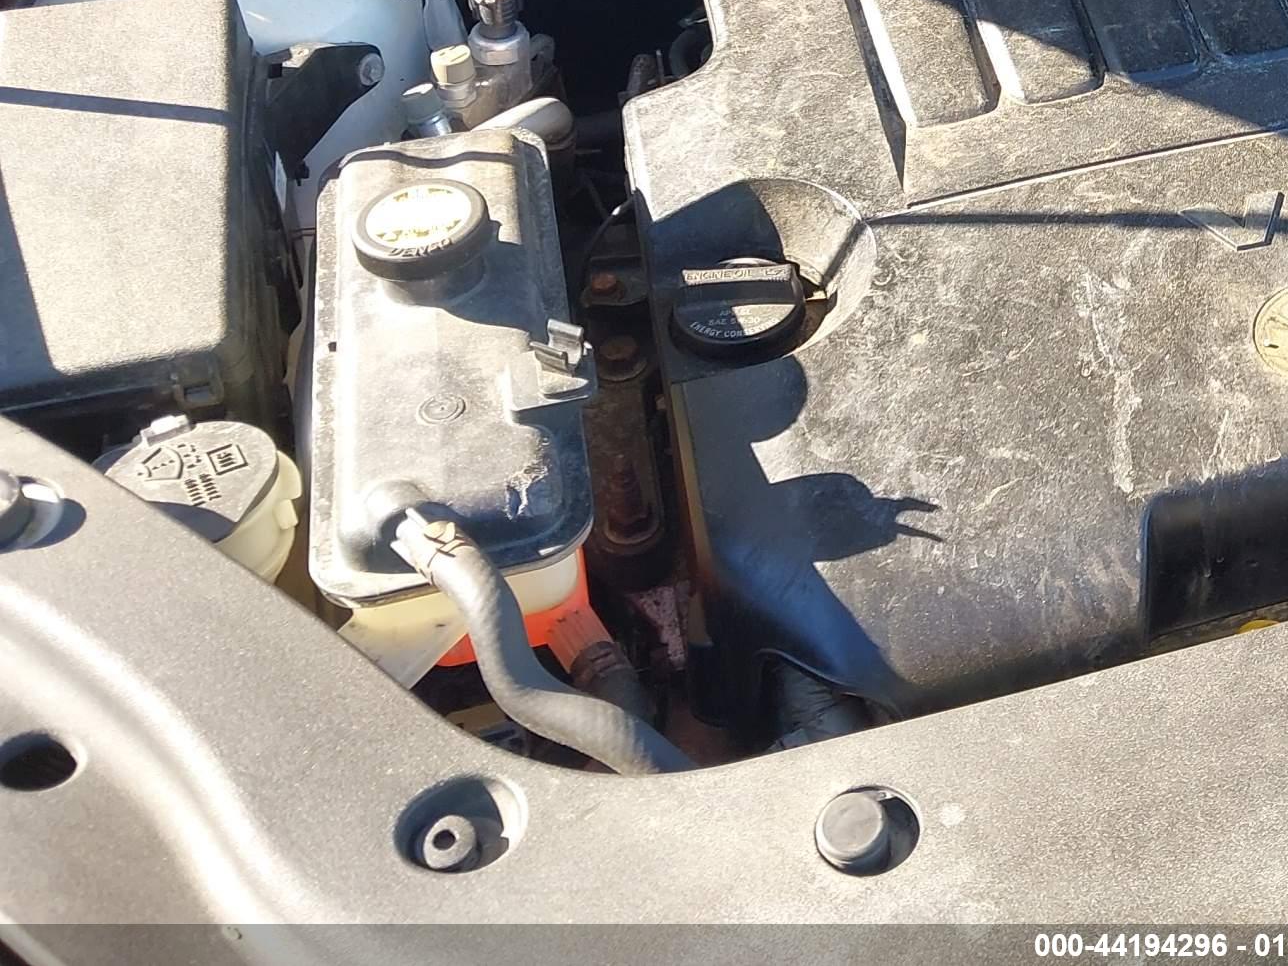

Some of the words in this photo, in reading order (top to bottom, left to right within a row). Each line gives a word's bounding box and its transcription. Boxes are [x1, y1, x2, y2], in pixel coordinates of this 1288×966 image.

[686, 270, 731, 282] ENGINE
[732, 270, 752, 280] OIL
[689, 320, 721, 338] ENERGY
